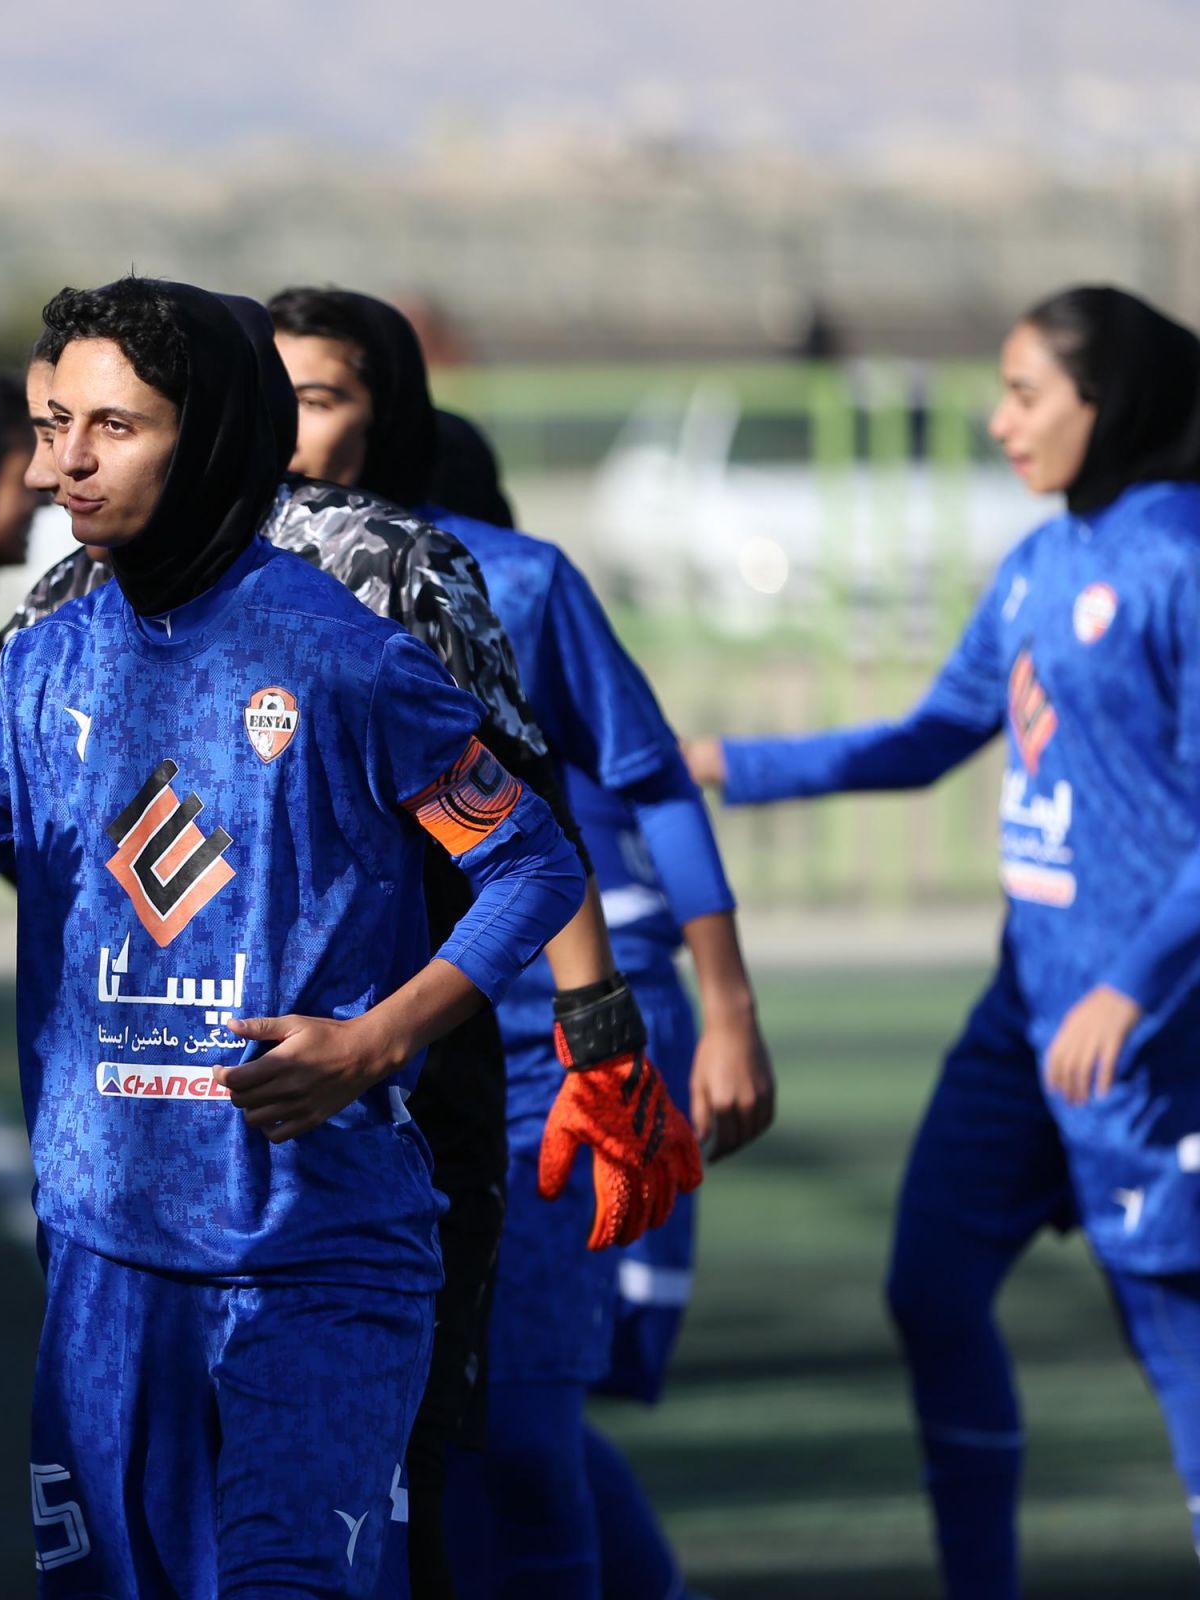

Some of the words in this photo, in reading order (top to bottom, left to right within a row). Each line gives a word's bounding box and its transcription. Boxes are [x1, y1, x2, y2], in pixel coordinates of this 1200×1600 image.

[249, 714, 292, 730] EESTA
[98, 931, 246, 1026] ایستا
[97, 1023, 129, 1050] ایستا
[131, 1026, 179, 1053] ماشین
[183, 1028, 247, 1054] سنگین
[122, 1074, 232, 1097] CHANGL
